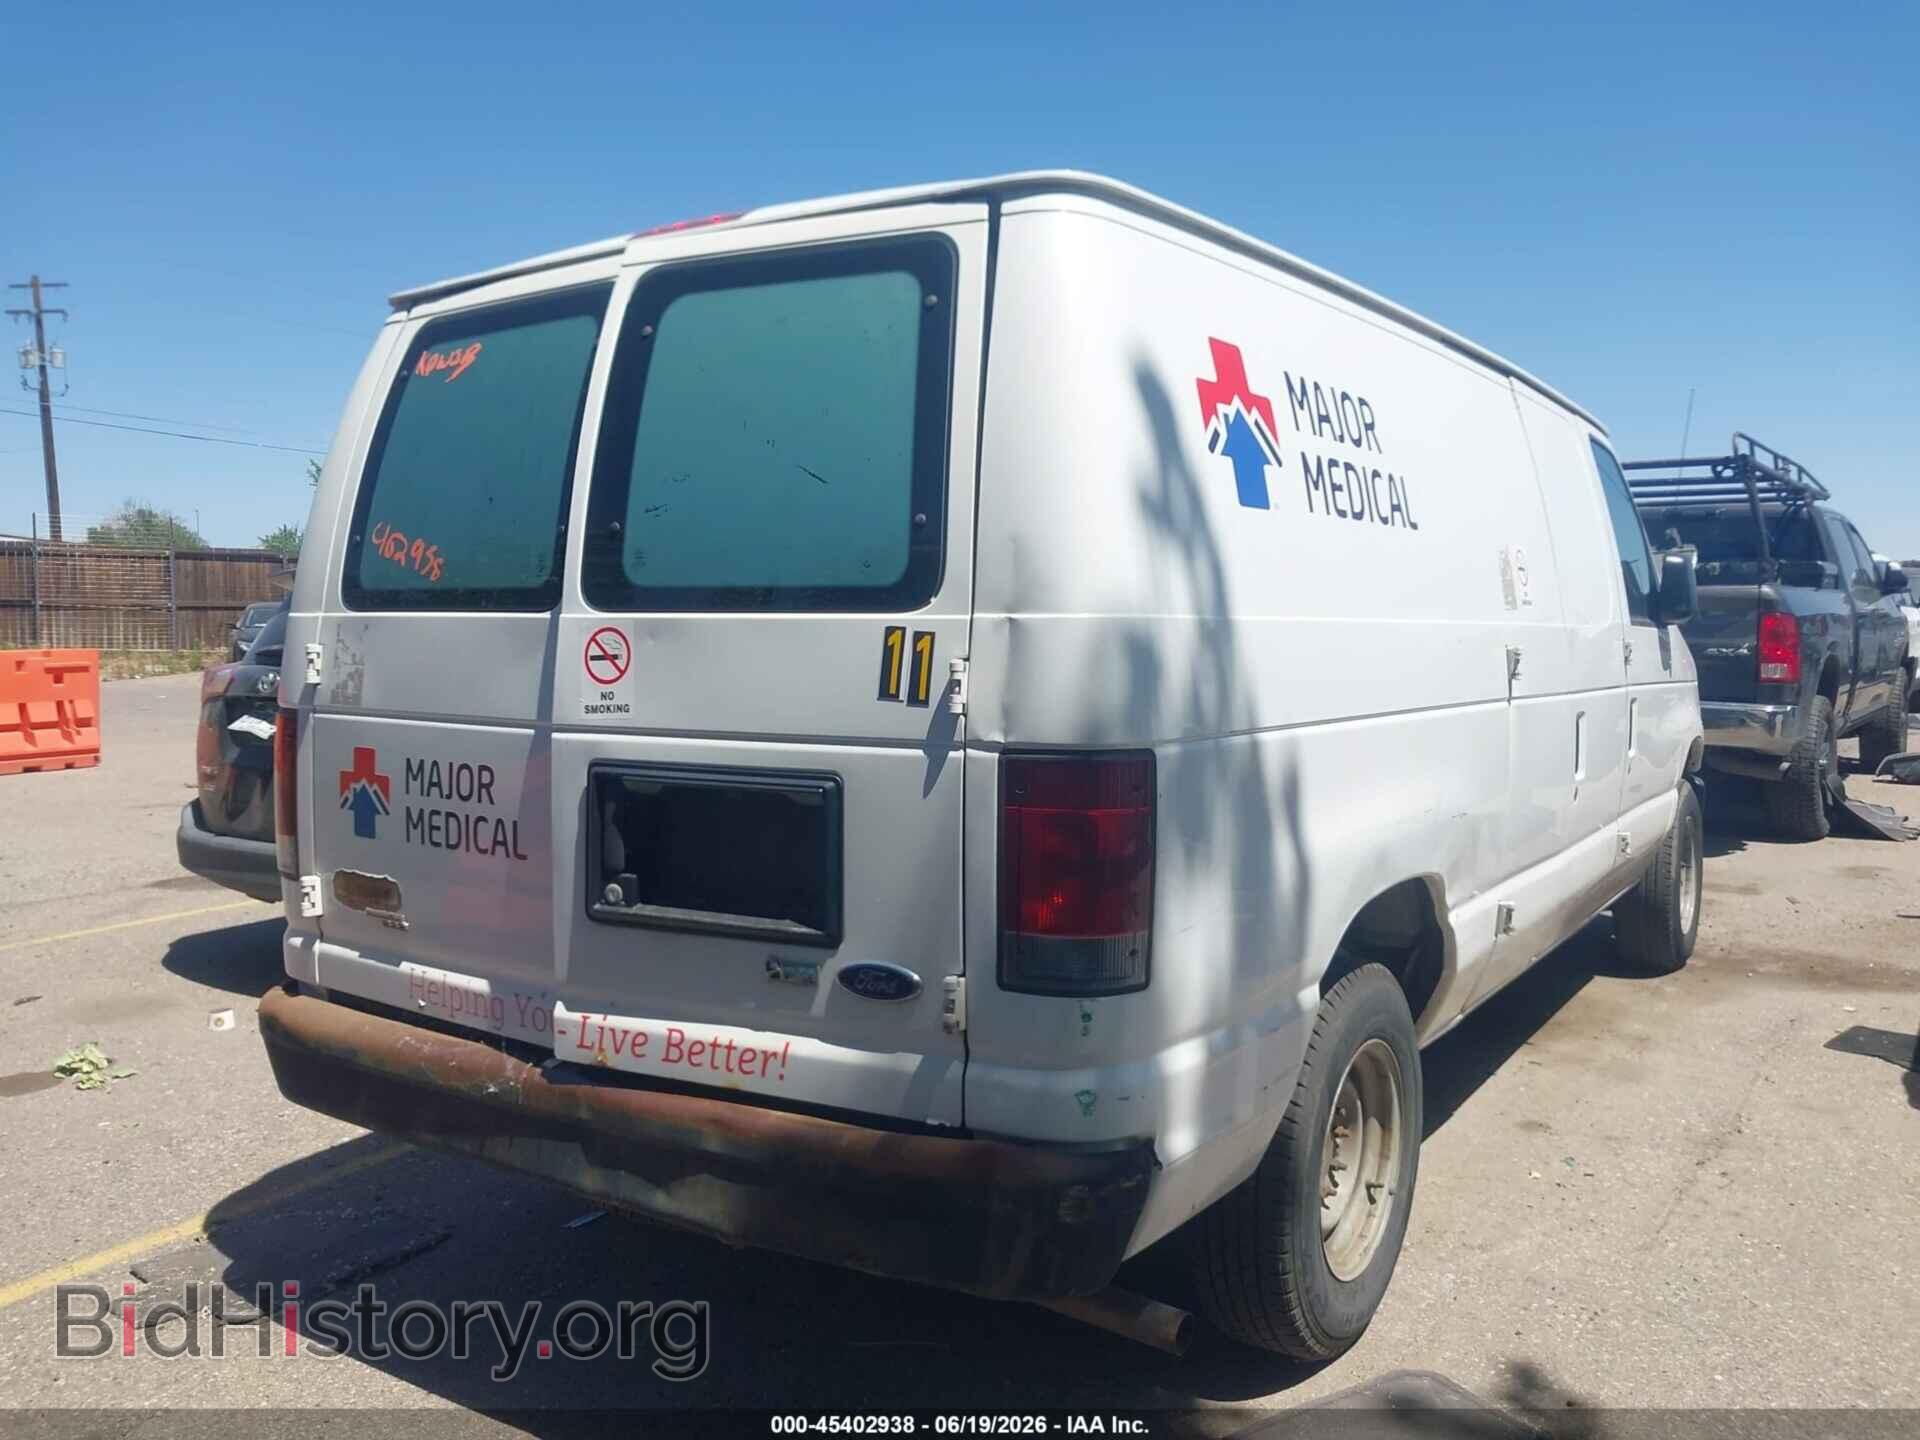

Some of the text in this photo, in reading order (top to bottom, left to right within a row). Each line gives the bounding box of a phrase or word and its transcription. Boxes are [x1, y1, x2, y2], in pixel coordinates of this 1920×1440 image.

[1284, 371, 1382, 454] MAJOR
[1301, 451, 1418, 531] MEDICAL
[600, 691, 615, 701] NO
[887, 628, 932, 701] 11
[584, 704, 630, 714] SMOKING
[405, 757, 495, 805] MAJOR
[405, 806, 528, 860] MEDICAL
[409, 967, 505, 1029] Helping
[514, 992, 555, 1032] Yo
[577, 1014, 649, 1058] Live
[661, 1028, 790, 1081] Better!
